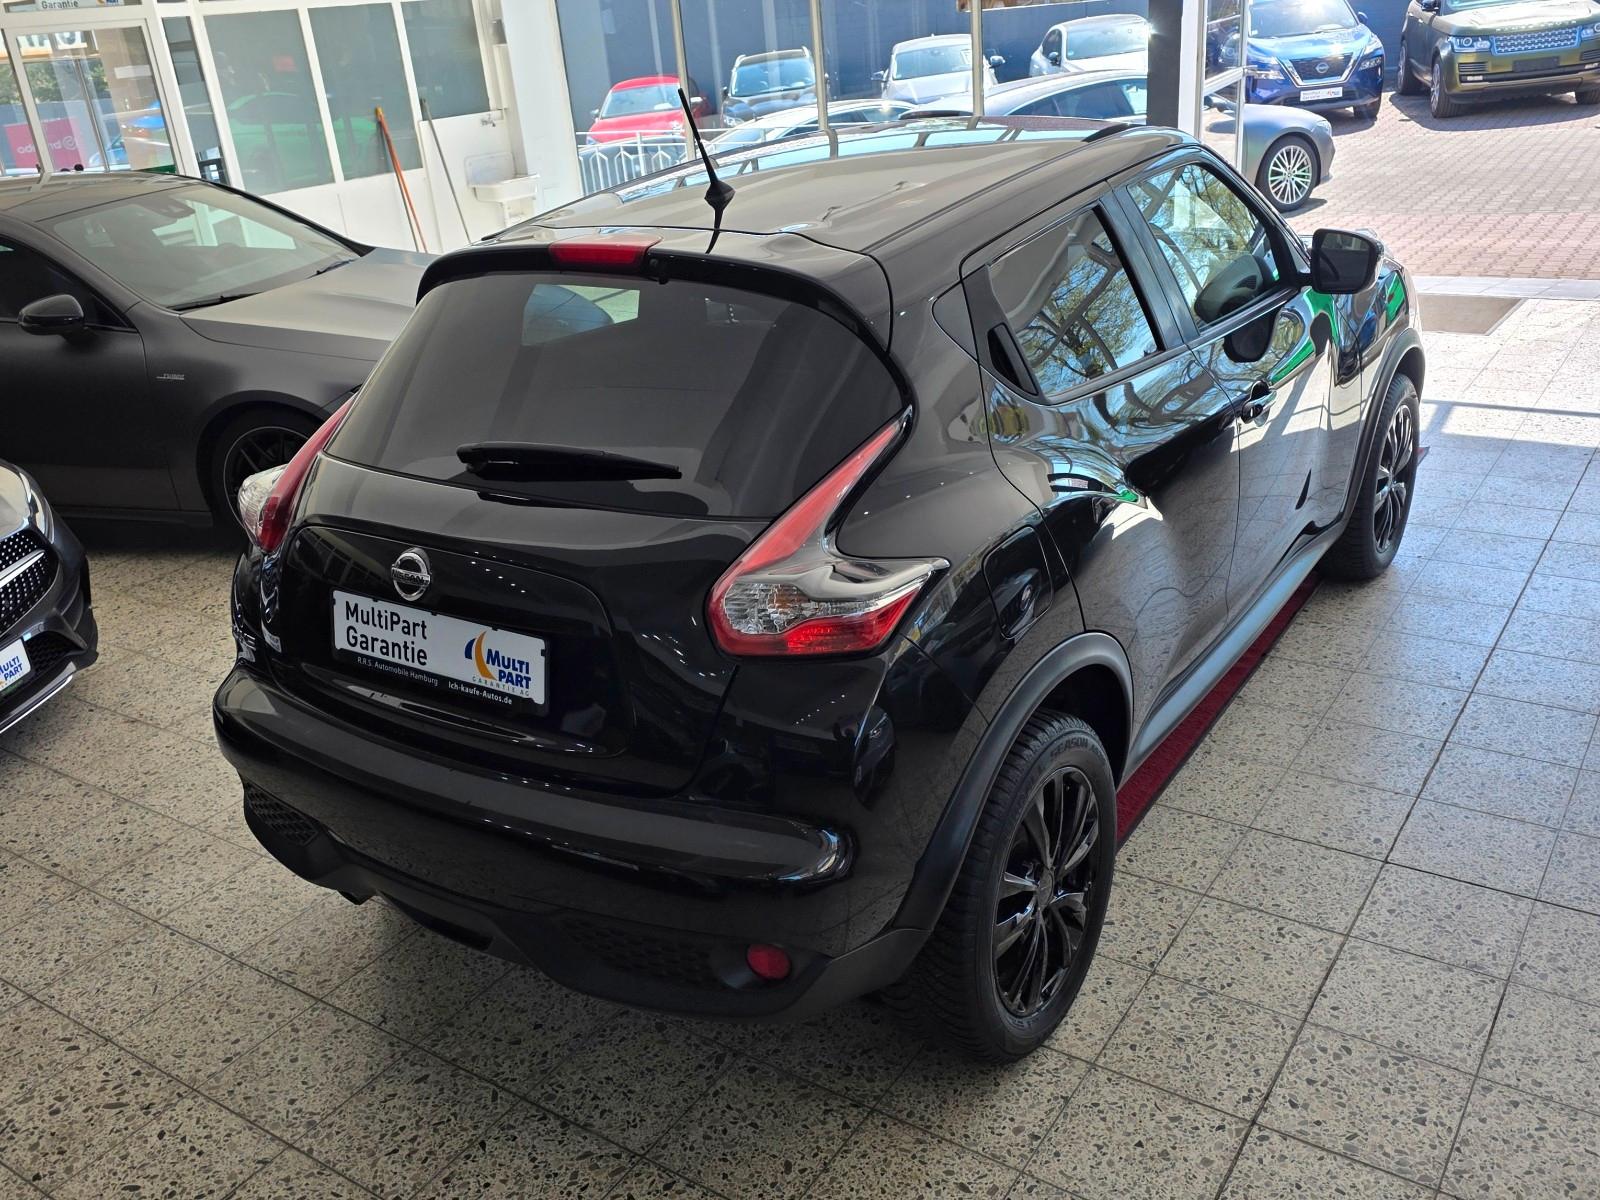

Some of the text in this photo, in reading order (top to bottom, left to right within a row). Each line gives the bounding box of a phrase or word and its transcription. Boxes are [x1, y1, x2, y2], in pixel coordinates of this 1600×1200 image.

[391, 568, 426, 585] NISSAN
[345, 600, 428, 640] MultiPart
[346, 626, 428, 666] Garantie
[4, 663, 23, 681] PART
[375, 662, 409, 677] Automobile
[410, 669, 439, 687] Hamburg
[498, 669, 532, 690] PART
